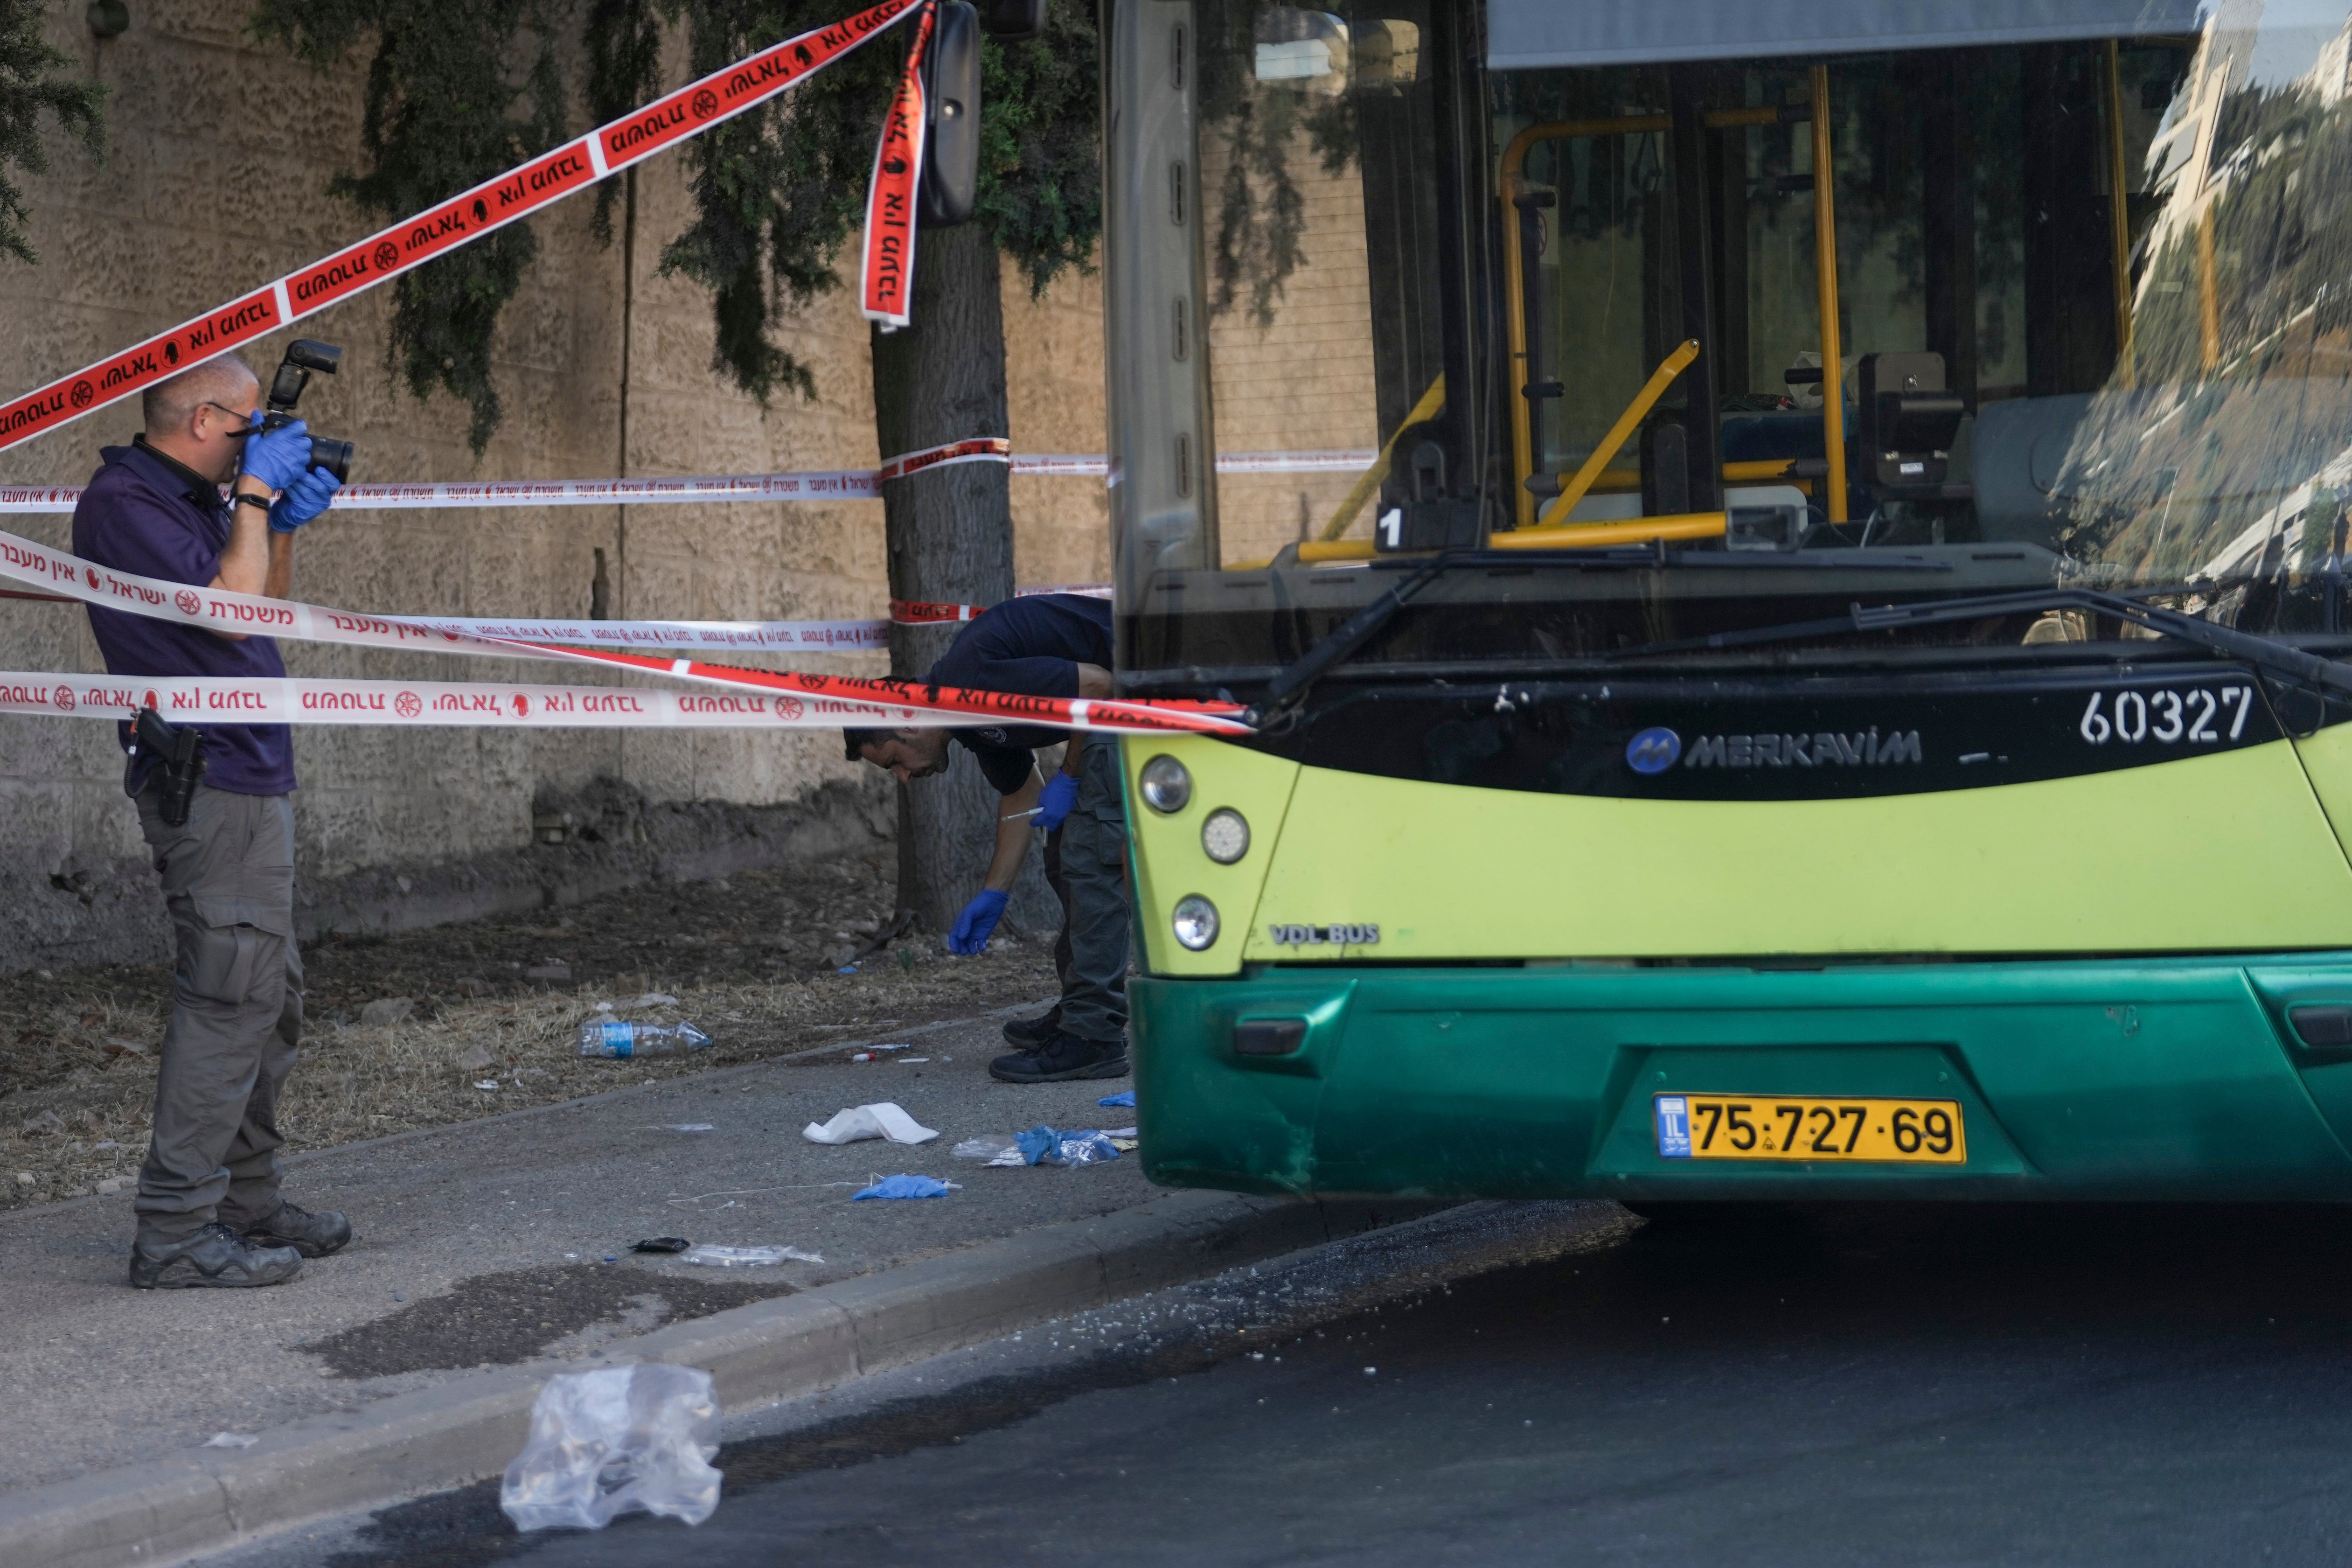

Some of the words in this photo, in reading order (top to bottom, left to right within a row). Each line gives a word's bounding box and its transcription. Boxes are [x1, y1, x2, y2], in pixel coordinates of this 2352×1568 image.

[100, 353, 158, 390] ישראל
[189, 320, 215, 350] אין
[220, 302, 272, 335] מעבר
[296, 254, 368, 300] משטרת
[406, 211, 466, 250] ישראל
[498, 175, 526, 207] אין
[531, 155, 584, 190] מעבר
[611, 103, 686, 153] משטרת
[725, 56, 790, 99] ישראל
[820, 21, 853, 50] אין
[884, 193, 906, 227] אין
[878, 235, 901, 301] מעבר
[1, 490, 28, 503] מעבר
[30, 490, 45, 506] אין
[1379, 508, 1401, 547] 1
[0, 542, 47, 572] מעבר
[52, 560, 76, 582] אין
[106, 574, 167, 606] ישראל
[209, 600, 294, 625] משטרת
[327, 614, 390, 635] מעבר
[0, 684, 48, 704] שטרת
[83, 687, 136, 711] ישראל
[172, 687, 200, 709] אין
[209, 689, 267, 709] מעבר
[302, 691, 385, 710] משטרת
[432, 693, 501, 716] ישראל
[544, 691, 574, 712] אין
[583, 694, 644, 712] מעבר
[679, 696, 766, 713] משטרת
[2080, 686, 2252, 743] 60327
[1268, 923, 1324, 945] VDL
[1329, 922, 1381, 945] BUS
[1666, 1114, 1684, 1137] IL
